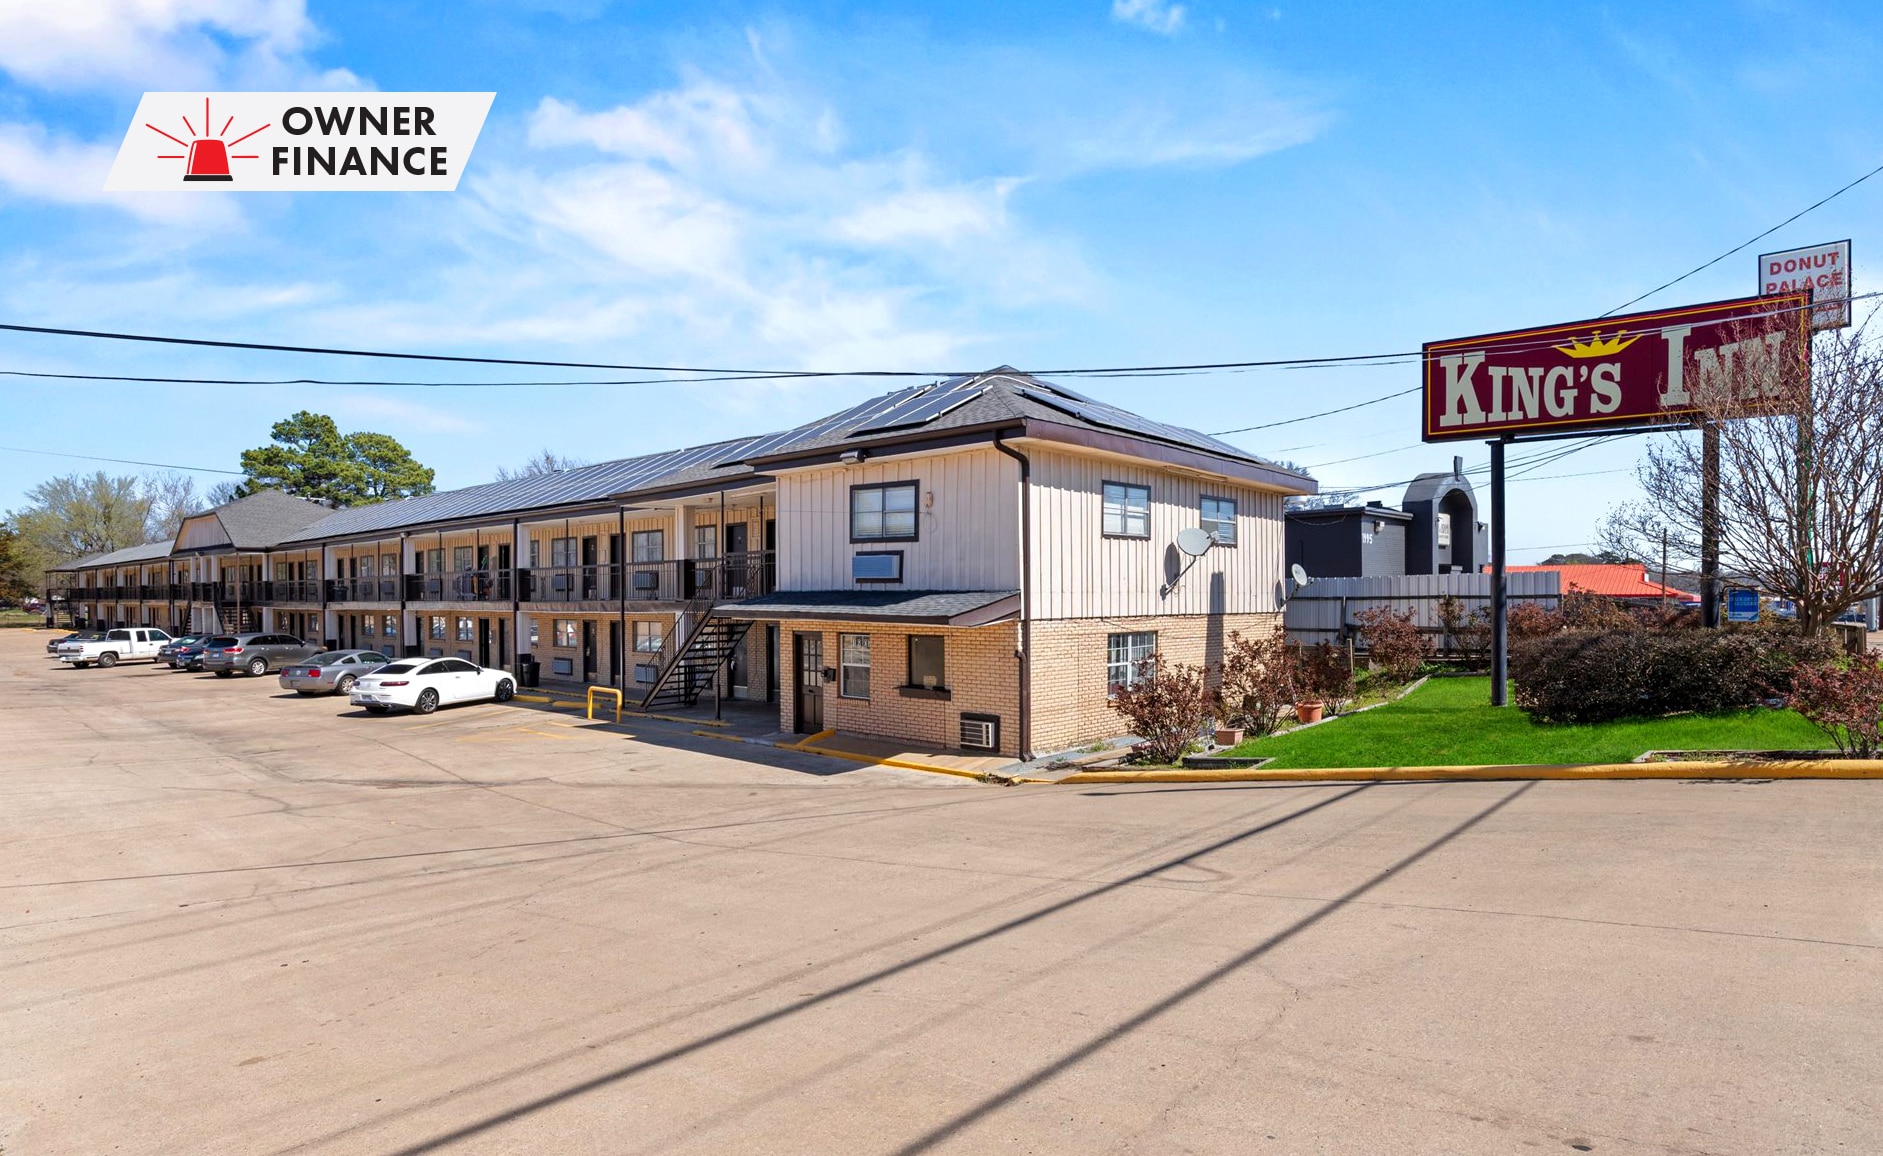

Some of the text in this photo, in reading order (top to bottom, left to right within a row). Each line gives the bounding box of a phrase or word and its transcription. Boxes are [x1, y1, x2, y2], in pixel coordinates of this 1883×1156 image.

[1769, 251, 1839, 276] DONUT
[1439, 323, 1787, 427] KING'S INN
